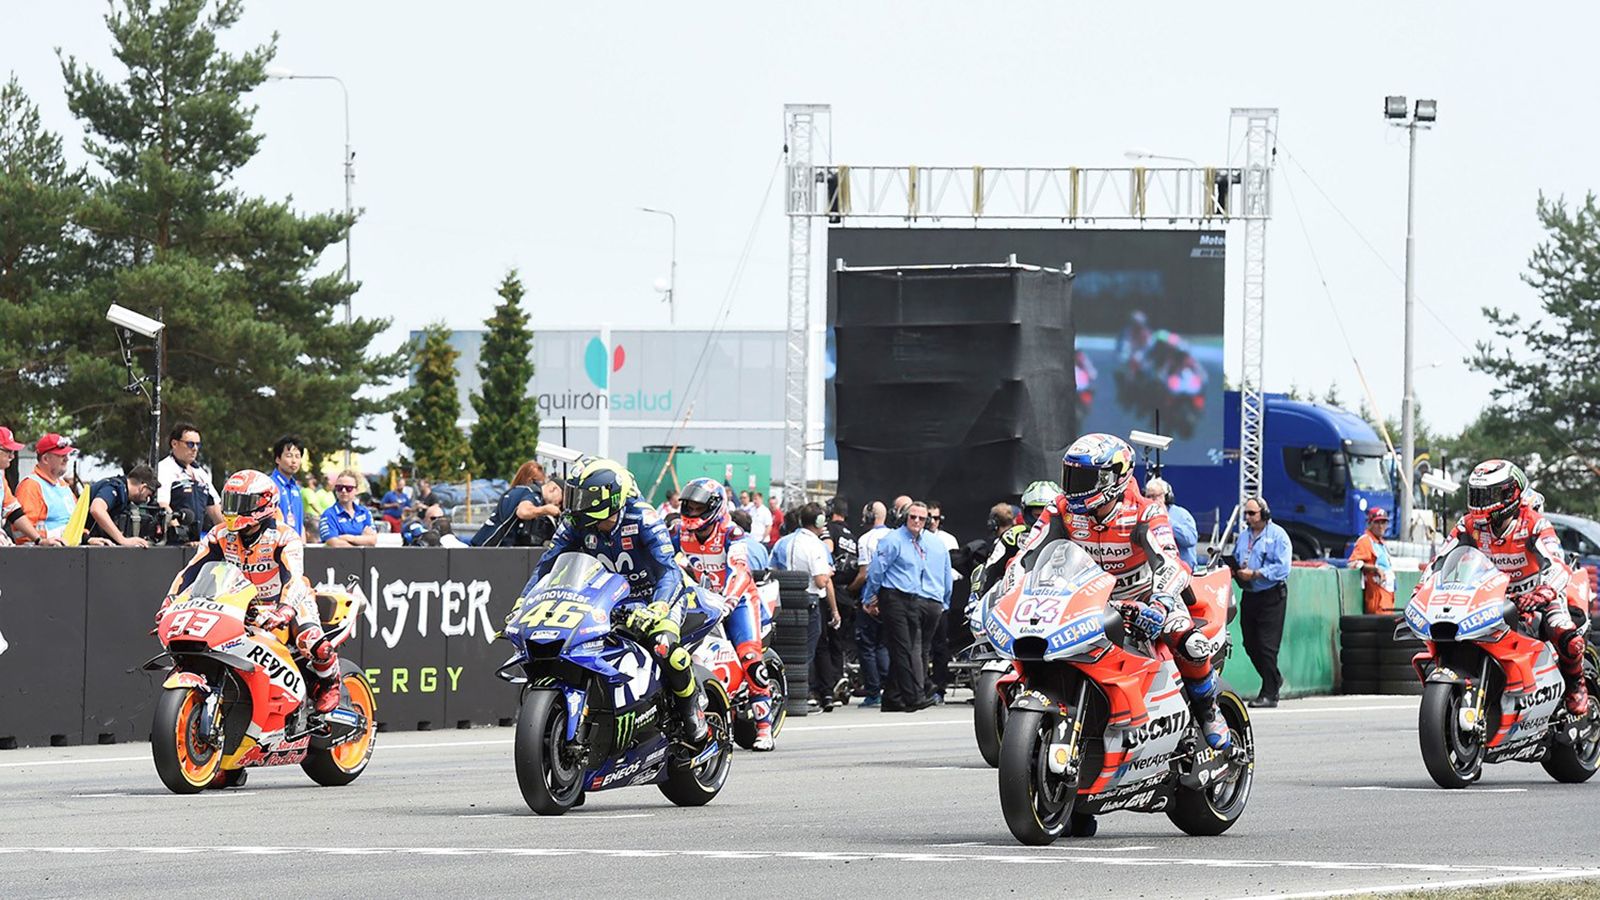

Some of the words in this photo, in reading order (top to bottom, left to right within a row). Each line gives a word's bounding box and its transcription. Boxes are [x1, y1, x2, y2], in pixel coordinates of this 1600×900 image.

[1085, 545, 1131, 557] NetApp
[1116, 571, 1141, 588] ATI
[1506, 580, 1535, 595] CATI
[172, 600, 225, 613] REPSOL
[314, 566, 496, 649] NSTER
[518, 600, 593, 629] 46
[1014, 597, 1061, 624] 04
[166, 609, 221, 639] 93
[1050, 615, 1102, 649] FLEX-BOX
[246, 644, 302, 694] REPSOL
[365, 666, 464, 694] ERGY
[1514, 682, 1563, 711] DUCATI
[1121, 710, 1186, 749] DUCATI
[601, 760, 642, 787] ENEOS
[1128, 752, 1173, 771] NetApp
